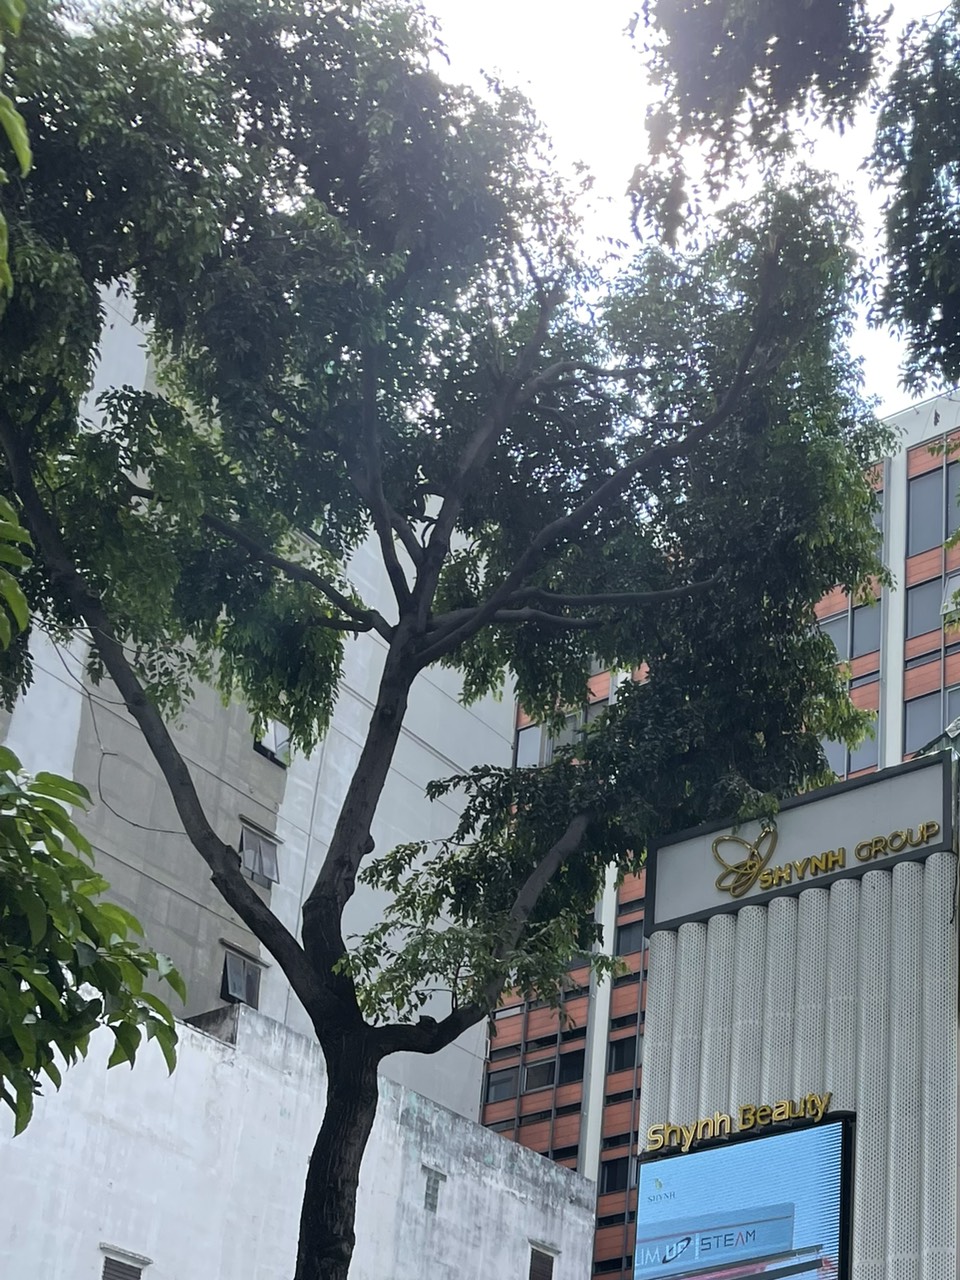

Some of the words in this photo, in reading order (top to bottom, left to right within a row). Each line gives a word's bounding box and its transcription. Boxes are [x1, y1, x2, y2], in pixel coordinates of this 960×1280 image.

[758, 847, 846, 890] SHYNH
[855, 820, 941, 862] GROUP
[647, 1111, 731, 1152] Shynh
[738, 1091, 833, 1131] Beauty
[701, 1231, 756, 1252] STEAM
